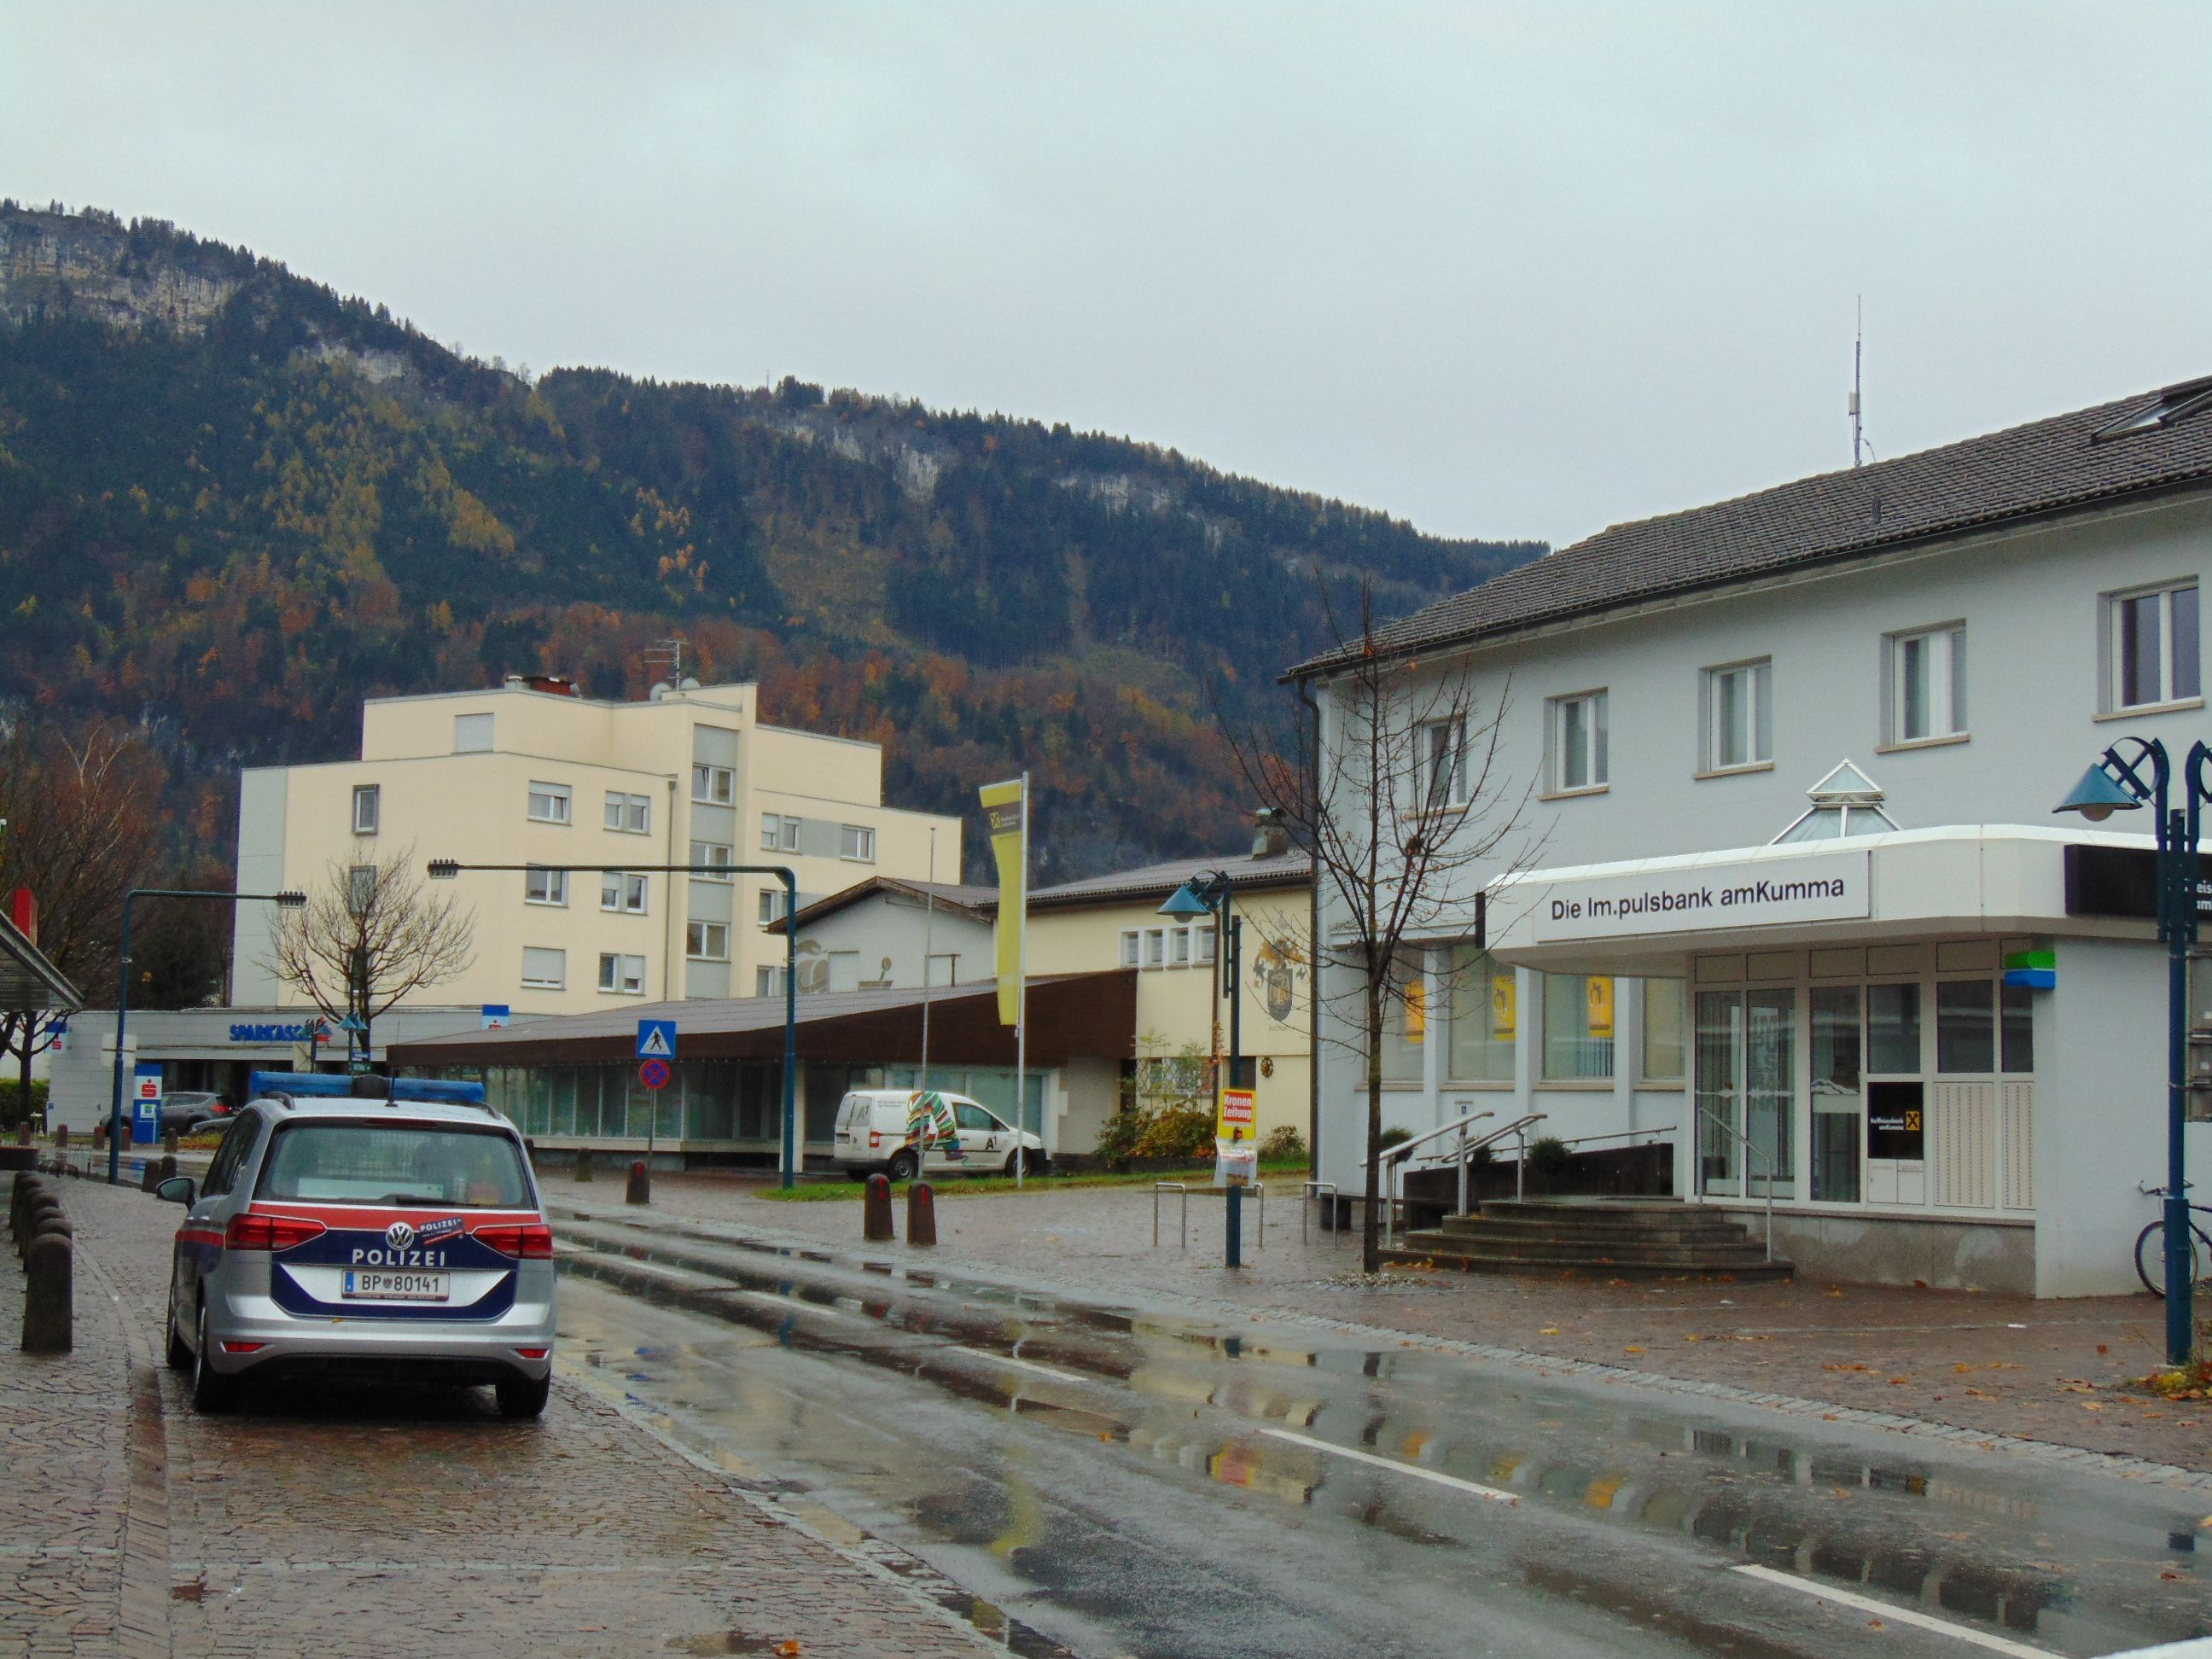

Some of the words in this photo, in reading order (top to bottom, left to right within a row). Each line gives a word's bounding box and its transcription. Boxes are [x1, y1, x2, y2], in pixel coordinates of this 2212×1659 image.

[1551, 899, 1580, 920] Die
[1588, 887, 1713, 920] Im.pulsbank
[1720, 879, 1845, 908] amKumma
[1224, 1096, 1252, 1107] Kronen
[1223, 1107, 1252, 1120] Zeitung
[420, 1219, 457, 1231] POLIZEI
[352, 1249, 445, 1266] POLIZEI
[362, 1275, 381, 1291] BP
[394, 1276, 439, 1292] 80141
